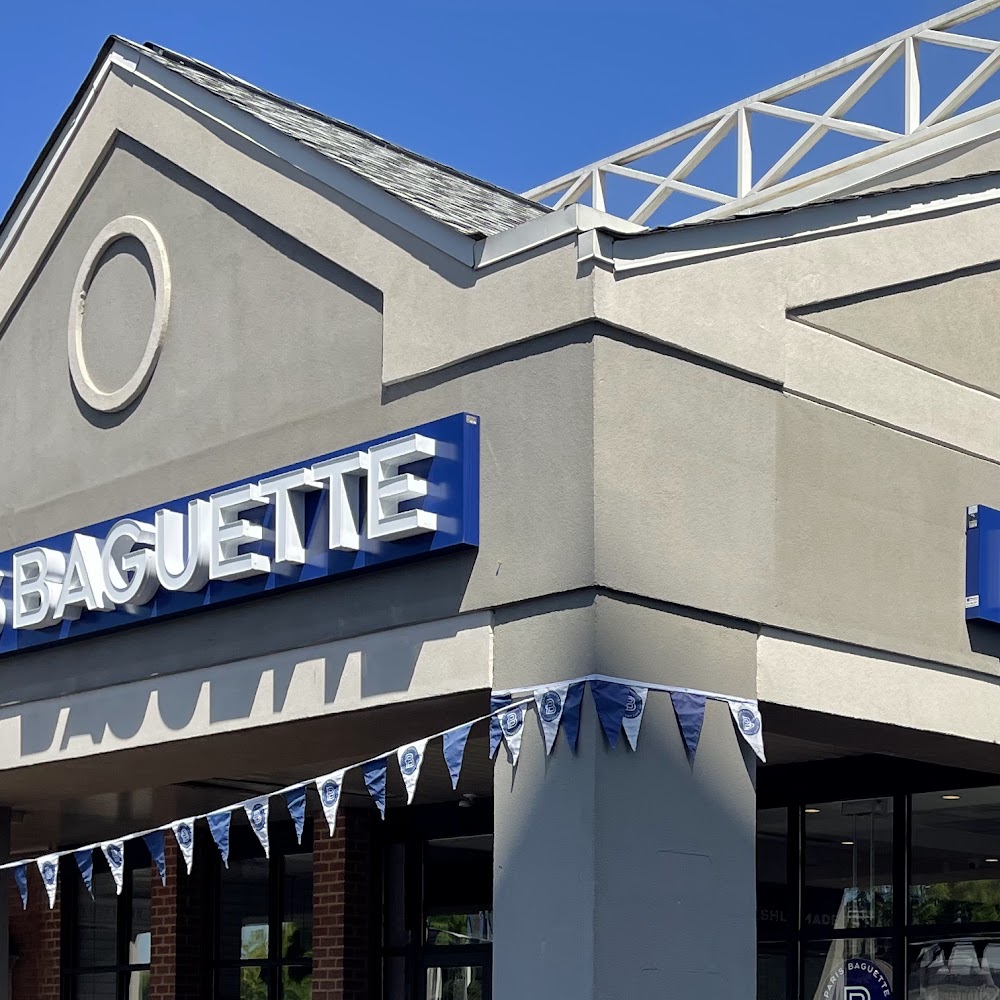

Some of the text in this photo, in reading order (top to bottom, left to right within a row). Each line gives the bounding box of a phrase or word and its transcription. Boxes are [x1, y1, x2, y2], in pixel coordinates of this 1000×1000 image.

[13, 433, 437, 629] BAGUETTE
[823, 962, 890, 998] PARIS BAGUETTE
